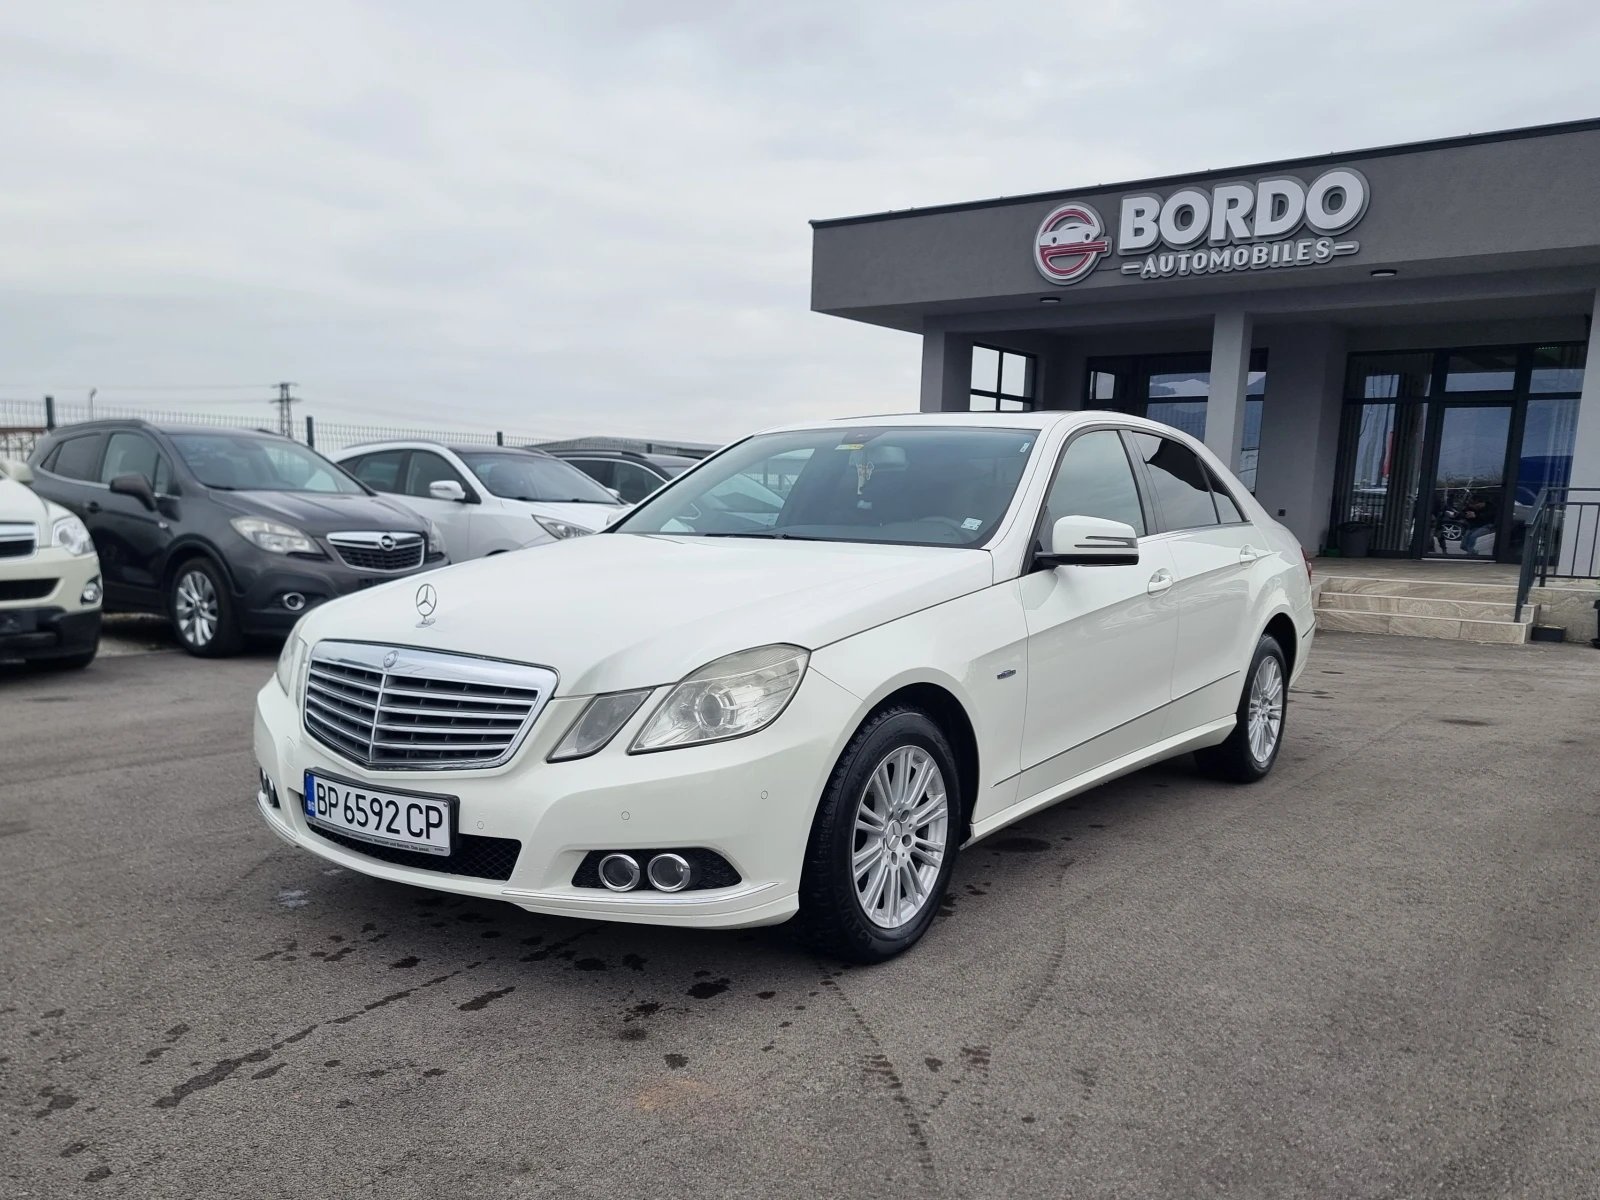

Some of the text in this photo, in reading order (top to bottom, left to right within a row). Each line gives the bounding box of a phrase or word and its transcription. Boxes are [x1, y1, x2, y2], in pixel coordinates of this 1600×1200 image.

[1119, 171, 1365, 250] BORDO
[1142, 240, 1330, 275] AUTOMOBILES
[316, 782, 443, 840] BP 6592 CP
